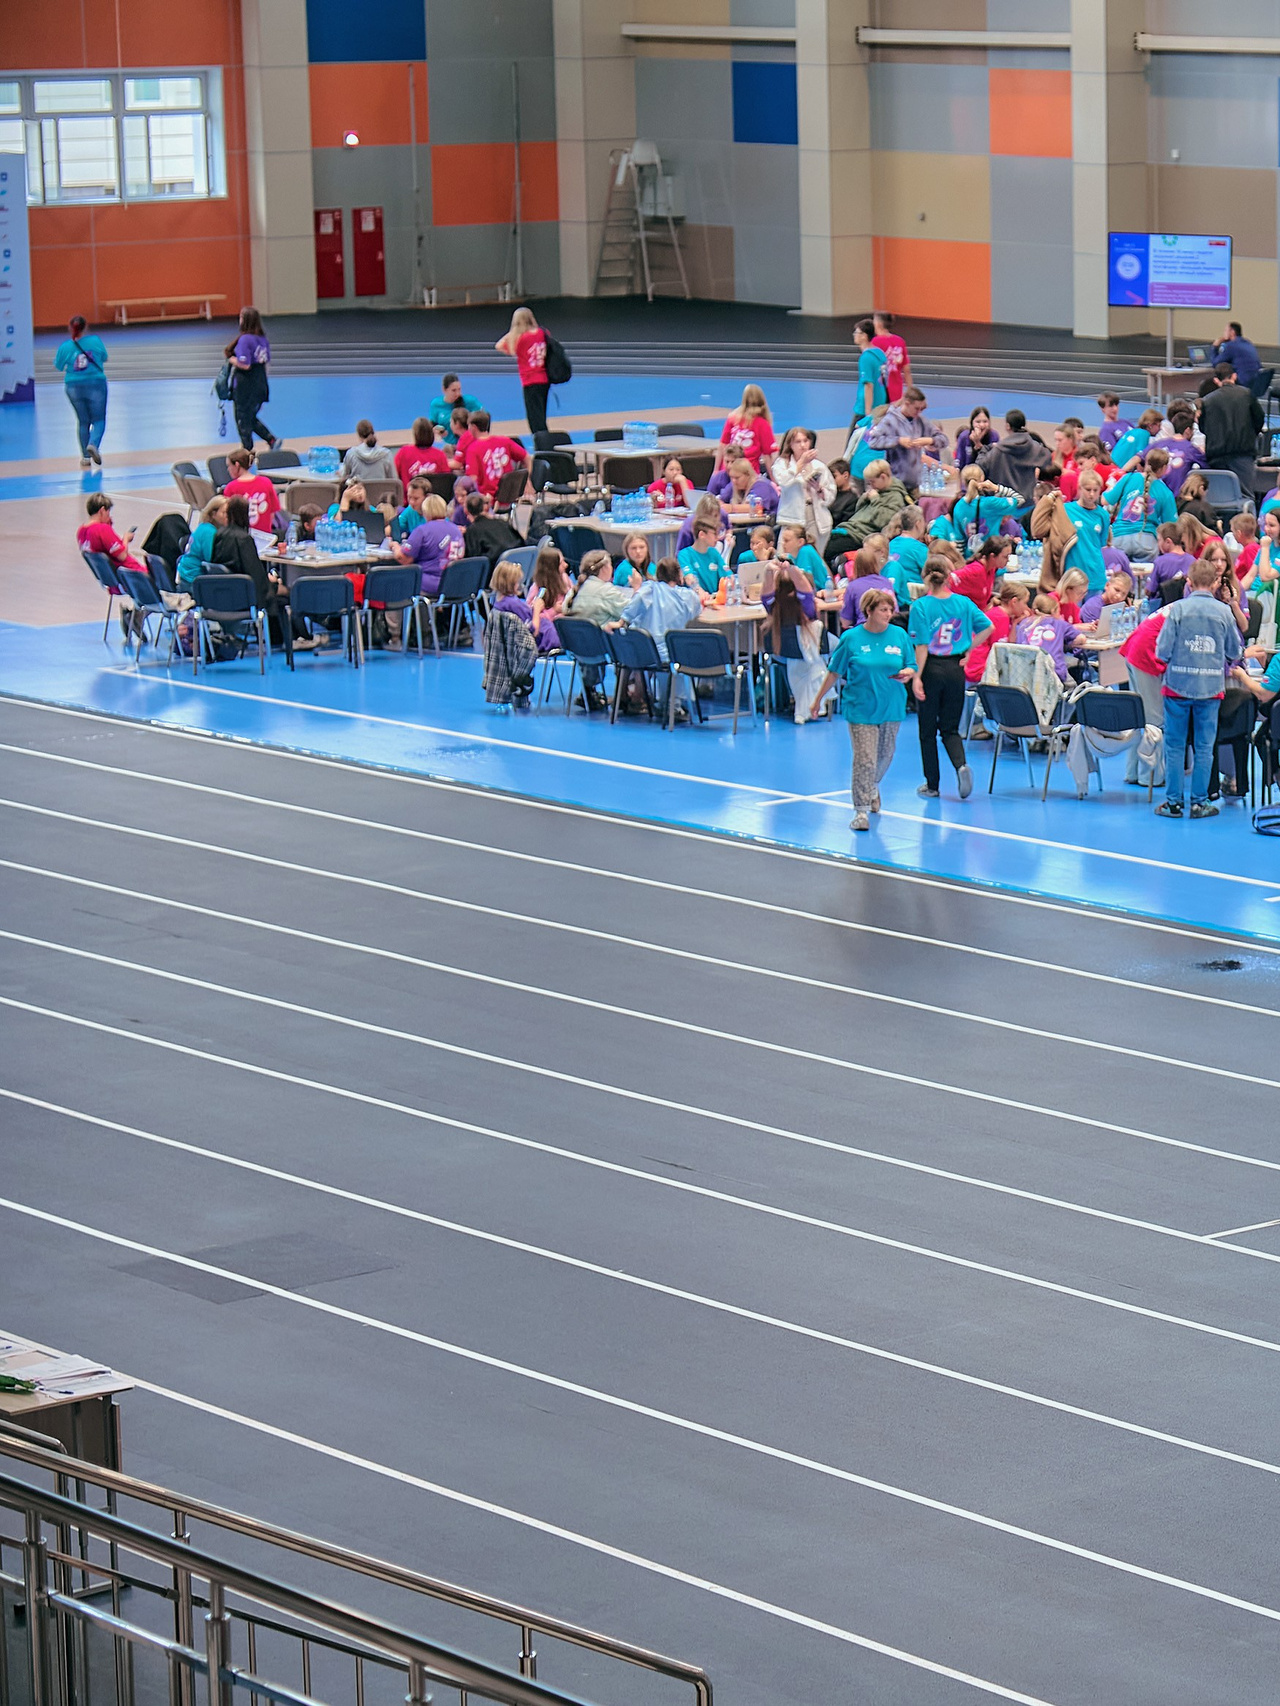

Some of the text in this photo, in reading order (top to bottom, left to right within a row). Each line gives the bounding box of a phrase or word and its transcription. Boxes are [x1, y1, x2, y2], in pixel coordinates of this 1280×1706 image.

[1131, 496, 1145, 513] 5
[940, 623, 953, 645] 5
[1031, 626, 1046, 641] 5
